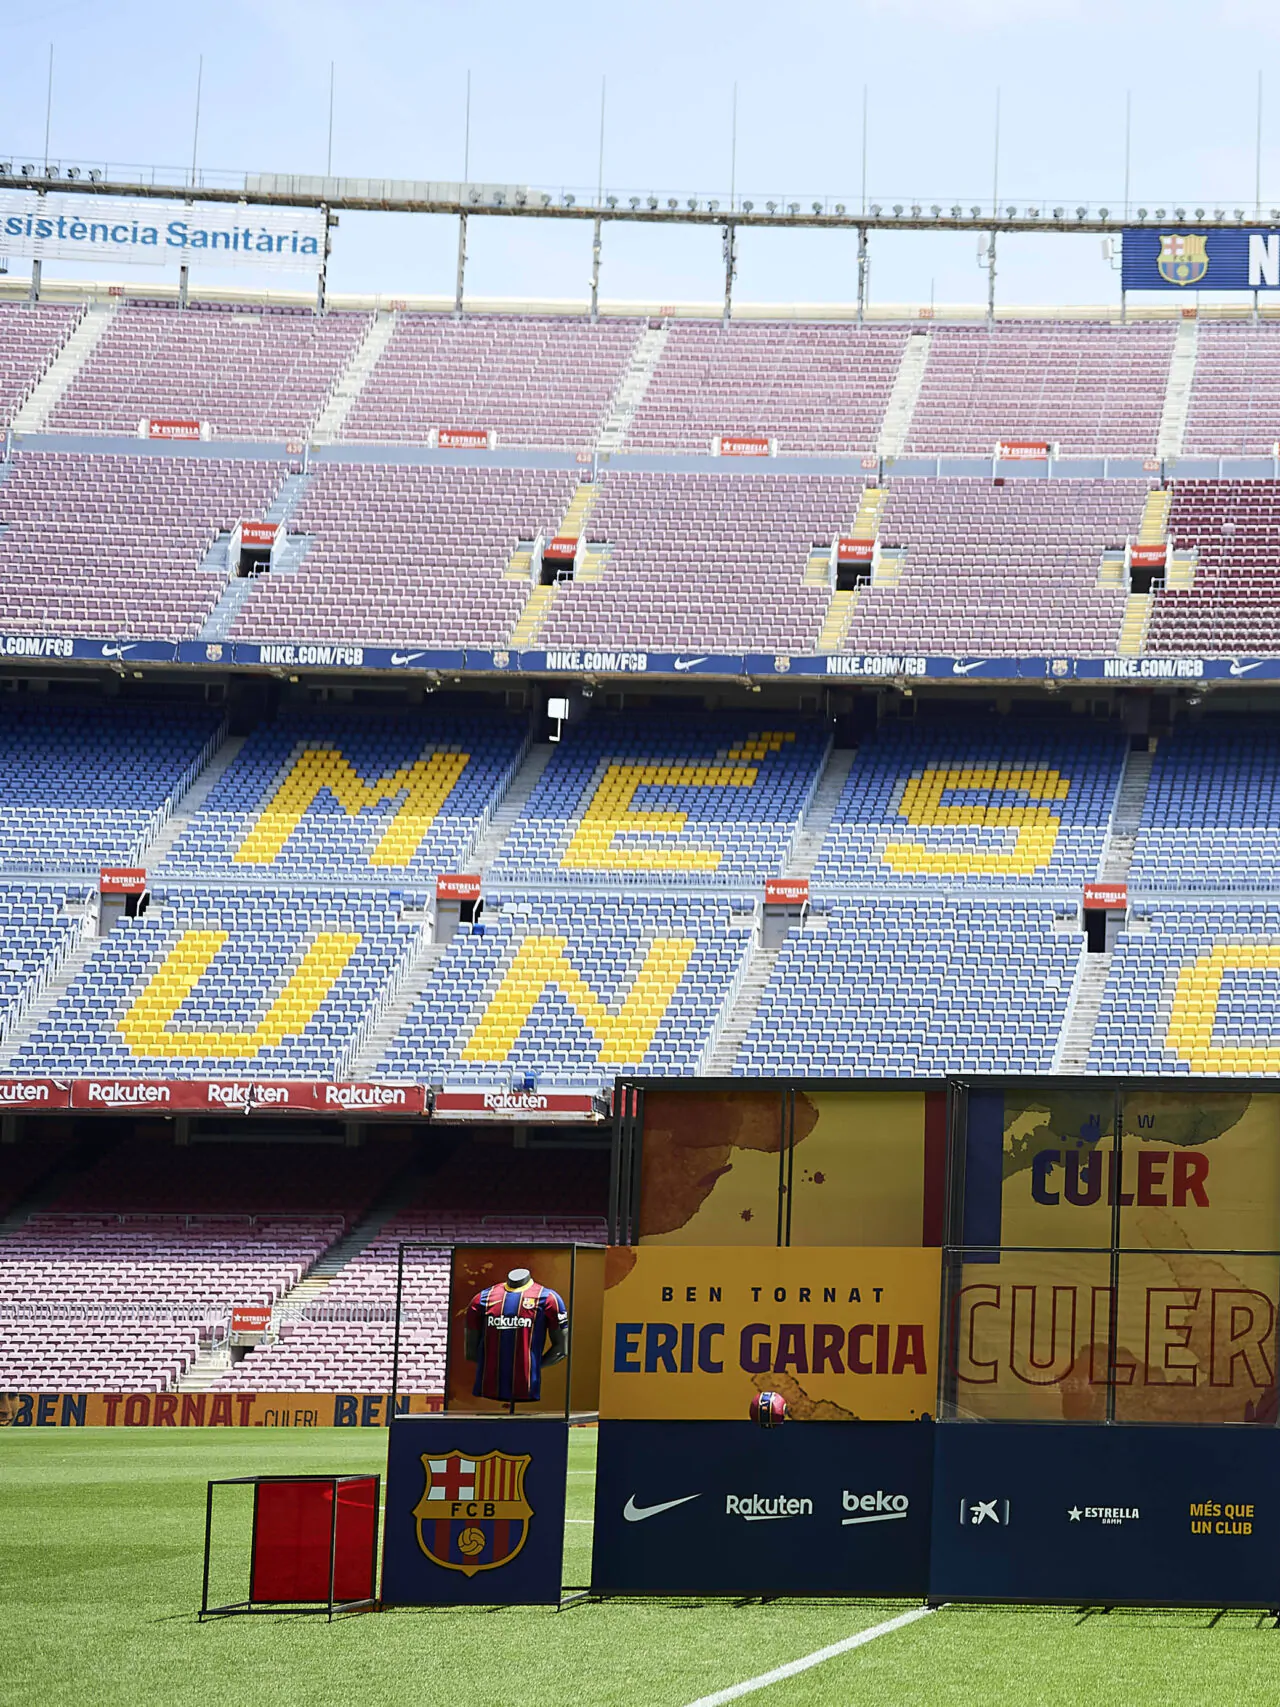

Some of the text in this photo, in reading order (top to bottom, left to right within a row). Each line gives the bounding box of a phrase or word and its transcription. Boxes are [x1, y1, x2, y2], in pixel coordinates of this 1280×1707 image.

[165, 221, 318, 255] Sanitària
[162, 426, 200, 435] ESTRELLA
[451, 436, 487, 445] ESTRELLA
[733, 443, 769, 452] ESTRELLA
[0, 636, 74, 657] .COM/FCB
[259, 645, 363, 666] NIKE.COM/FCB
[546, 651, 647, 671] NIKE.COM/FCB
[1104, 659, 1203, 677] NIKE.COM/FCB
[111, 876, 146, 884] ESTRELLA
[447, 882, 480, 890] ESTRELLA
[776, 887, 808, 895] ESTRELLA
[117, 930, 695, 1066] UN
[89, 1083, 170, 1101] Rakuten
[326, 1085, 405, 1104] Rakuten
[484, 1094, 547, 1108] Rakuten
[1032, 1149, 1210, 1208] CULER
[661, 1287, 884, 1303] BEN TORNAT
[488, 1315, 532, 1328] Rakuten
[950, 1284, 1275, 1387] CULER
[614, 1322, 927, 1375] ERIC GARCIA
[12, 1394, 88, 1427] BEN
[333, 1395, 410, 1427] BEN
[451, 1503, 495, 1517] FCB
[726, 1494, 813, 1515] Rakuten
[842, 1491, 909, 1512] beko
[1190, 1501, 1255, 1520] MÉS QUE
[1085, 1507, 1139, 1519] ESTRELLA
[1191, 1521, 1252, 1535] UN CLUB
